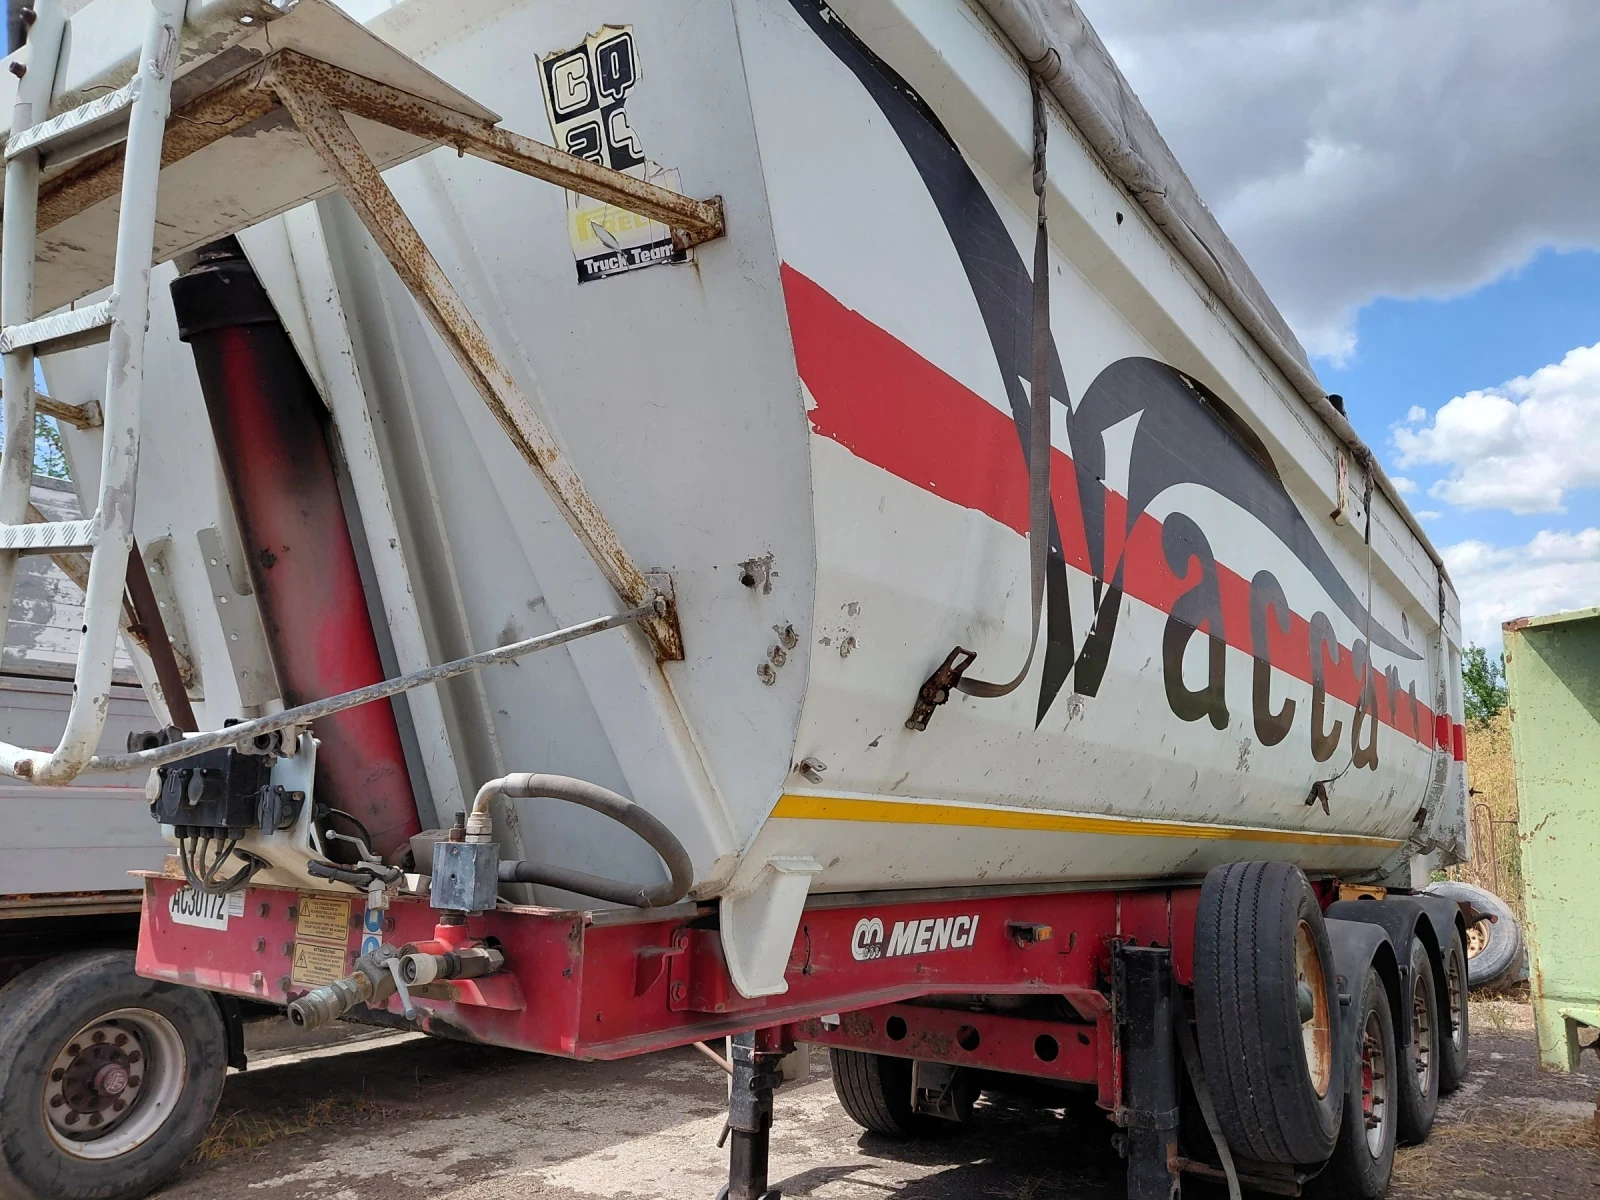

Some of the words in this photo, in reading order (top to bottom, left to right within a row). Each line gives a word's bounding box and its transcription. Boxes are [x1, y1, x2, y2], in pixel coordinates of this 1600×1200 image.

[584, 252, 629, 275] Truck
[631, 243, 674, 265] Team
[886, 915, 979, 957] MENCI
